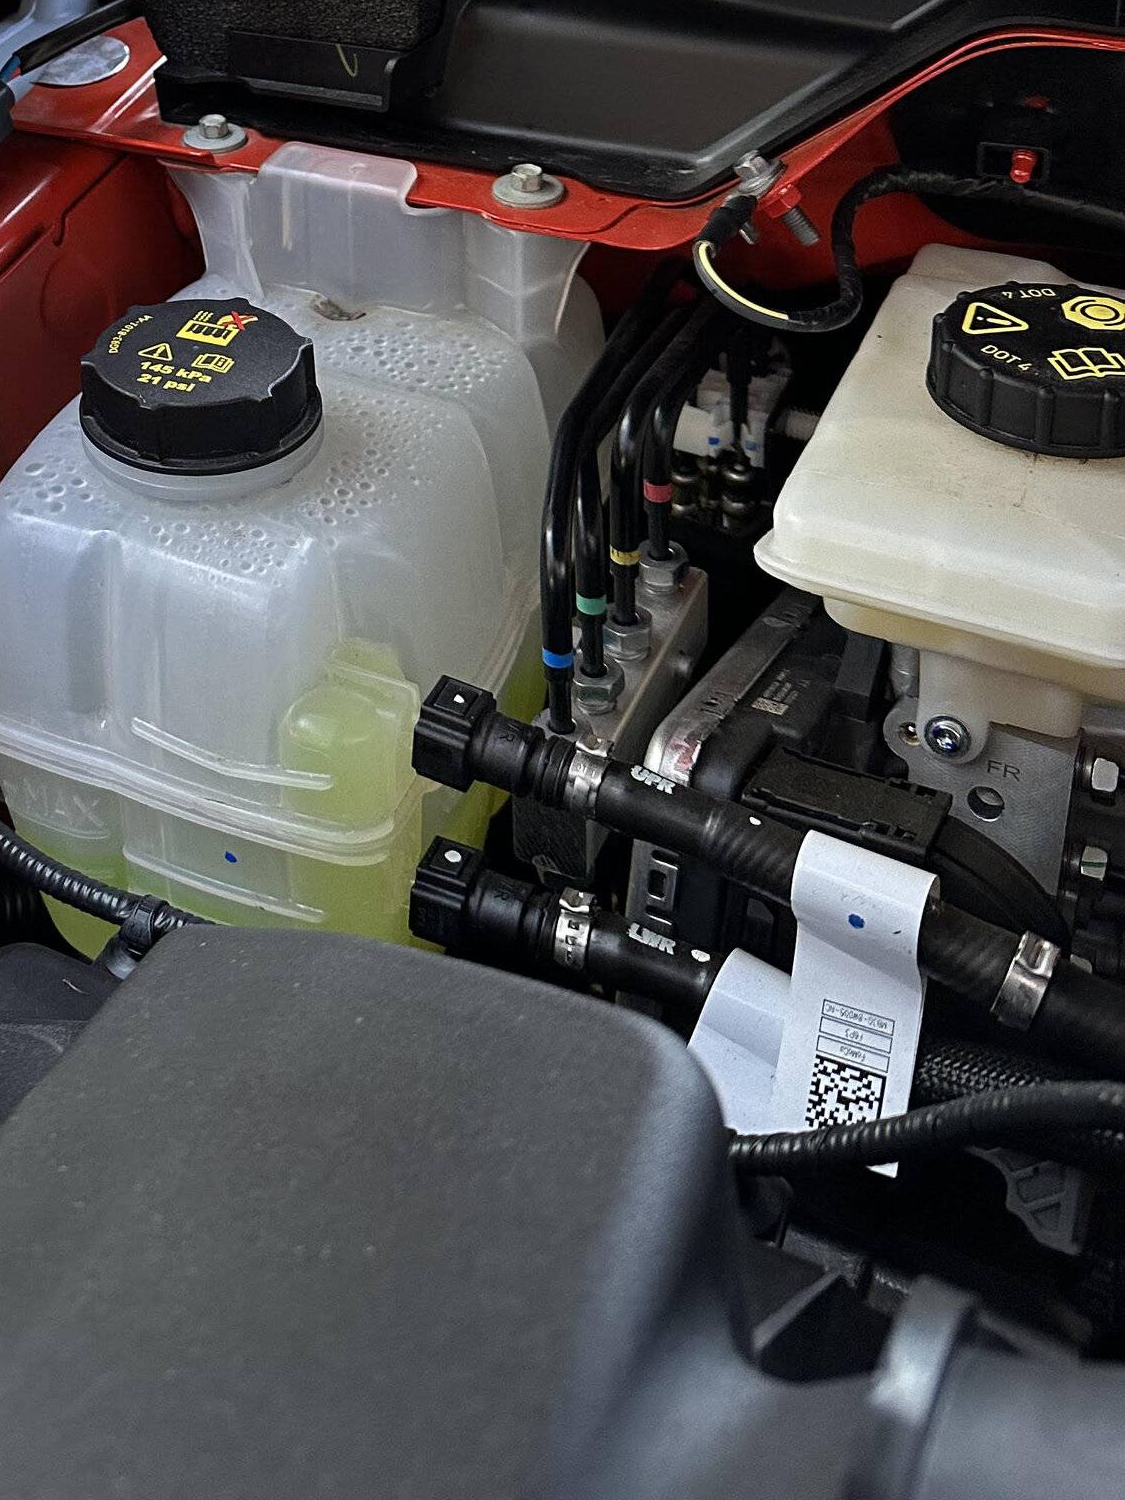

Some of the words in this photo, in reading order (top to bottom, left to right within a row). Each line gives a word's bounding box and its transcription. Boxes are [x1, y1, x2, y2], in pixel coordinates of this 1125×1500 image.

[1002, 291, 1014, 299] 4
[1020, 288, 1056, 298] DOT
[980, 344, 1022, 365] DOT
[1019, 362, 1033, 372] 4
[136, 373, 163, 385] 21
[162, 379, 196, 393] psi
[140, 360, 175, 376] 145
[175, 369, 212, 384] kPa
[630, 764, 677, 794] UPR
[987, 759, 1021, 782] FR
[23, 779, 105, 828] MAX
[627, 922, 676, 955] LWR
